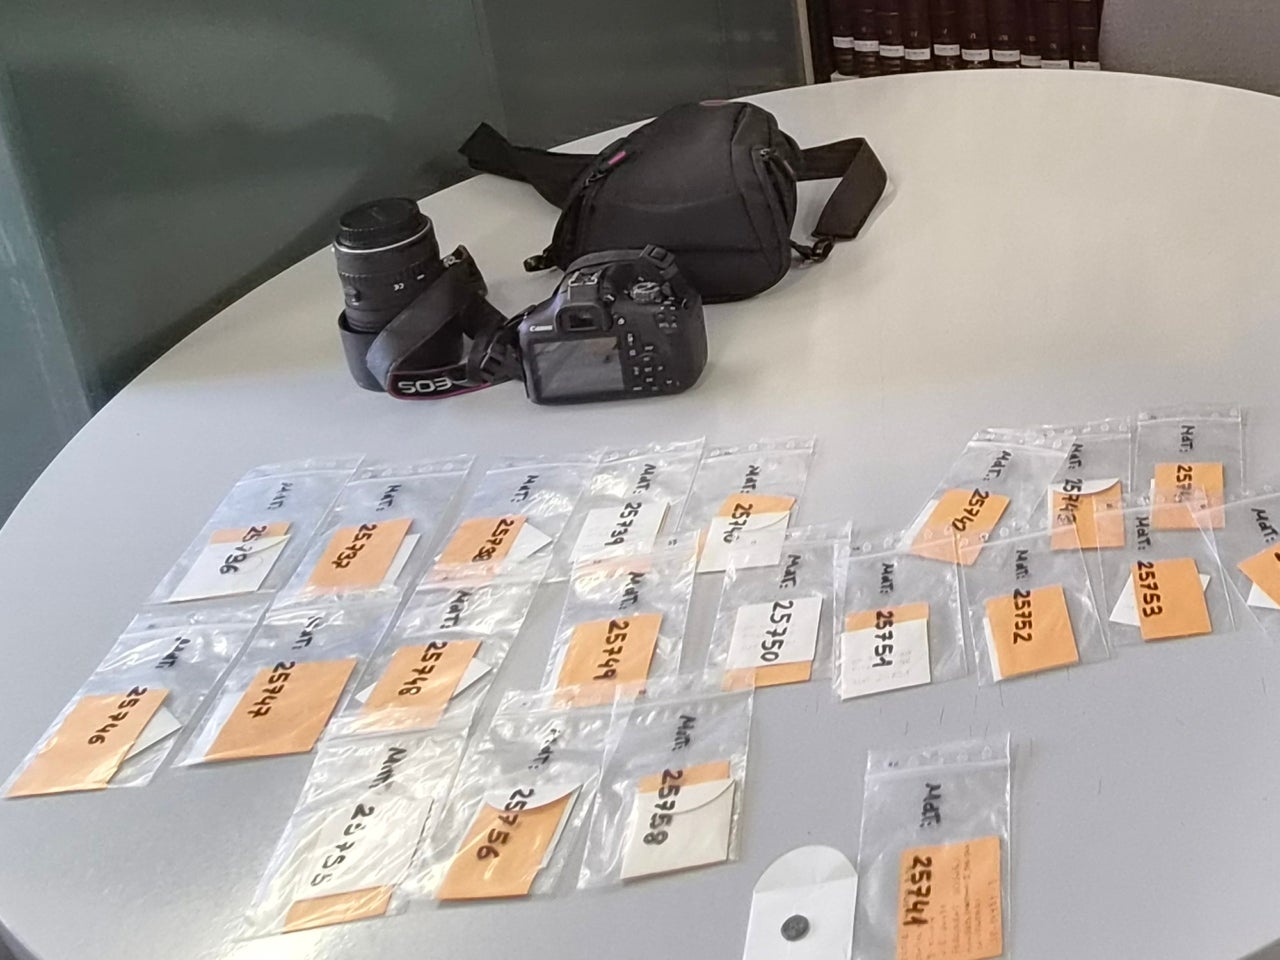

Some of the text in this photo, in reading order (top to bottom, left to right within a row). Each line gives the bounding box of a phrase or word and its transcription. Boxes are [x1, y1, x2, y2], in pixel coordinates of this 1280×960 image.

[399, 380, 452, 394] EOS
[332, 523, 378, 569] 25737
[604, 502, 643, 547] 25739
[1012, 588, 1033, 645] 25752
[1137, 559, 1163, 619] 25753
[592, 619, 630, 681] 25749
[760, 600, 794, 662] 25750
[872, 609, 896, 668] 25751
[248, 661, 296, 718] 25747
[397, 641, 448, 697] 25748
[87, 686, 148, 745] 25746
[476, 788, 536, 861] 25756
[643, 768, 684, 847] 25758
[903, 855, 933, 927] 25741
